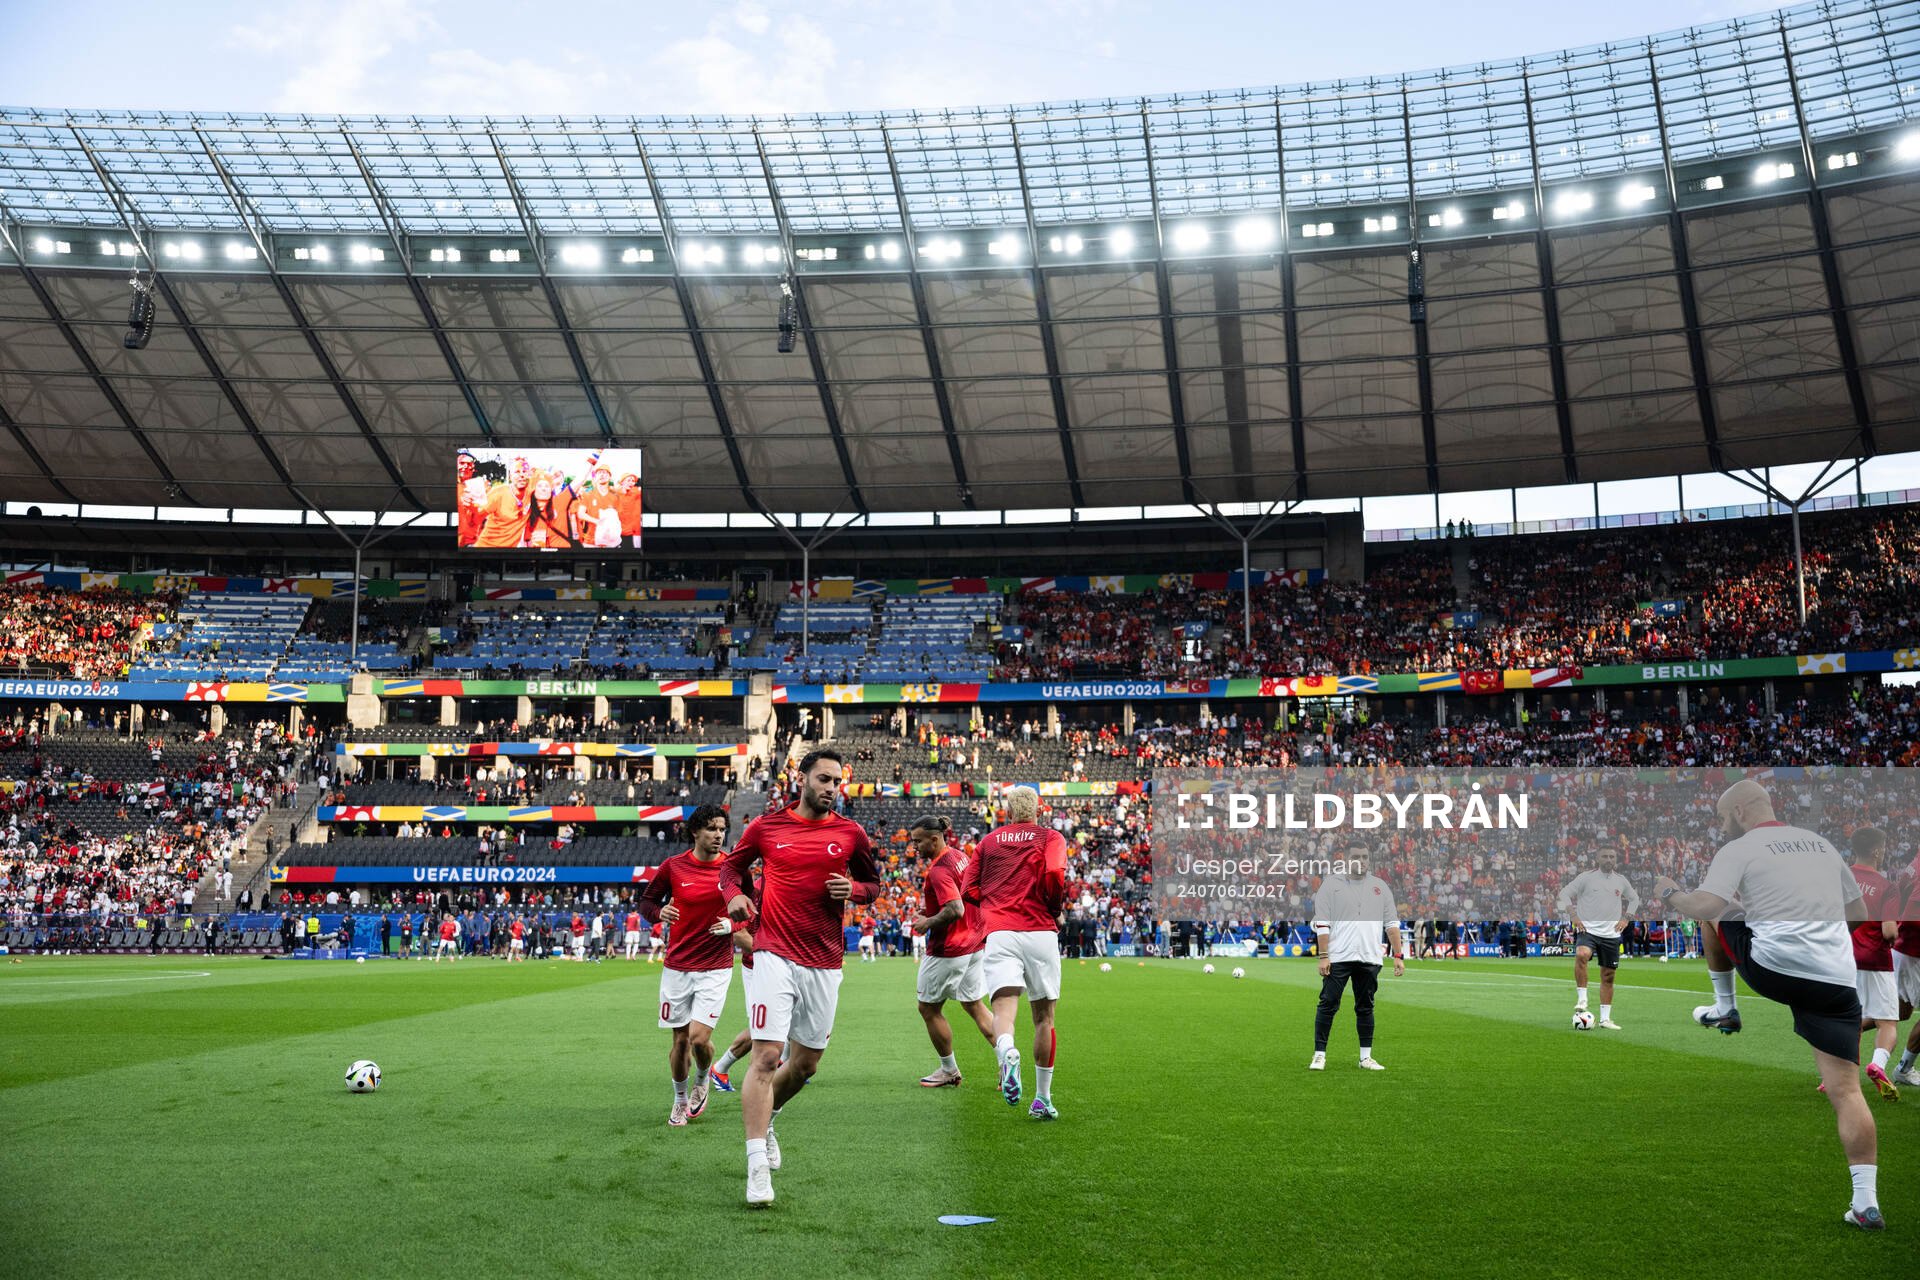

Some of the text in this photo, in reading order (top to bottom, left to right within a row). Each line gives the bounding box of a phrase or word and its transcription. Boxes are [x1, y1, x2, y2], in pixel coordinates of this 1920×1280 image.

[1662, 603, 1676, 612] 12
[1461, 614, 1473, 623] 11
[1190, 624, 1204, 633] 10
[1642, 664, 1724, 679] BERLIN
[0, 682, 120, 697] EFAEURO2024
[525, 681, 597, 695] BERLIN
[995, 830, 1036, 843] TÜRKİYE
[1765, 838, 1826, 855] TÜRKİYE
[751, 1003, 767, 1029] 10
